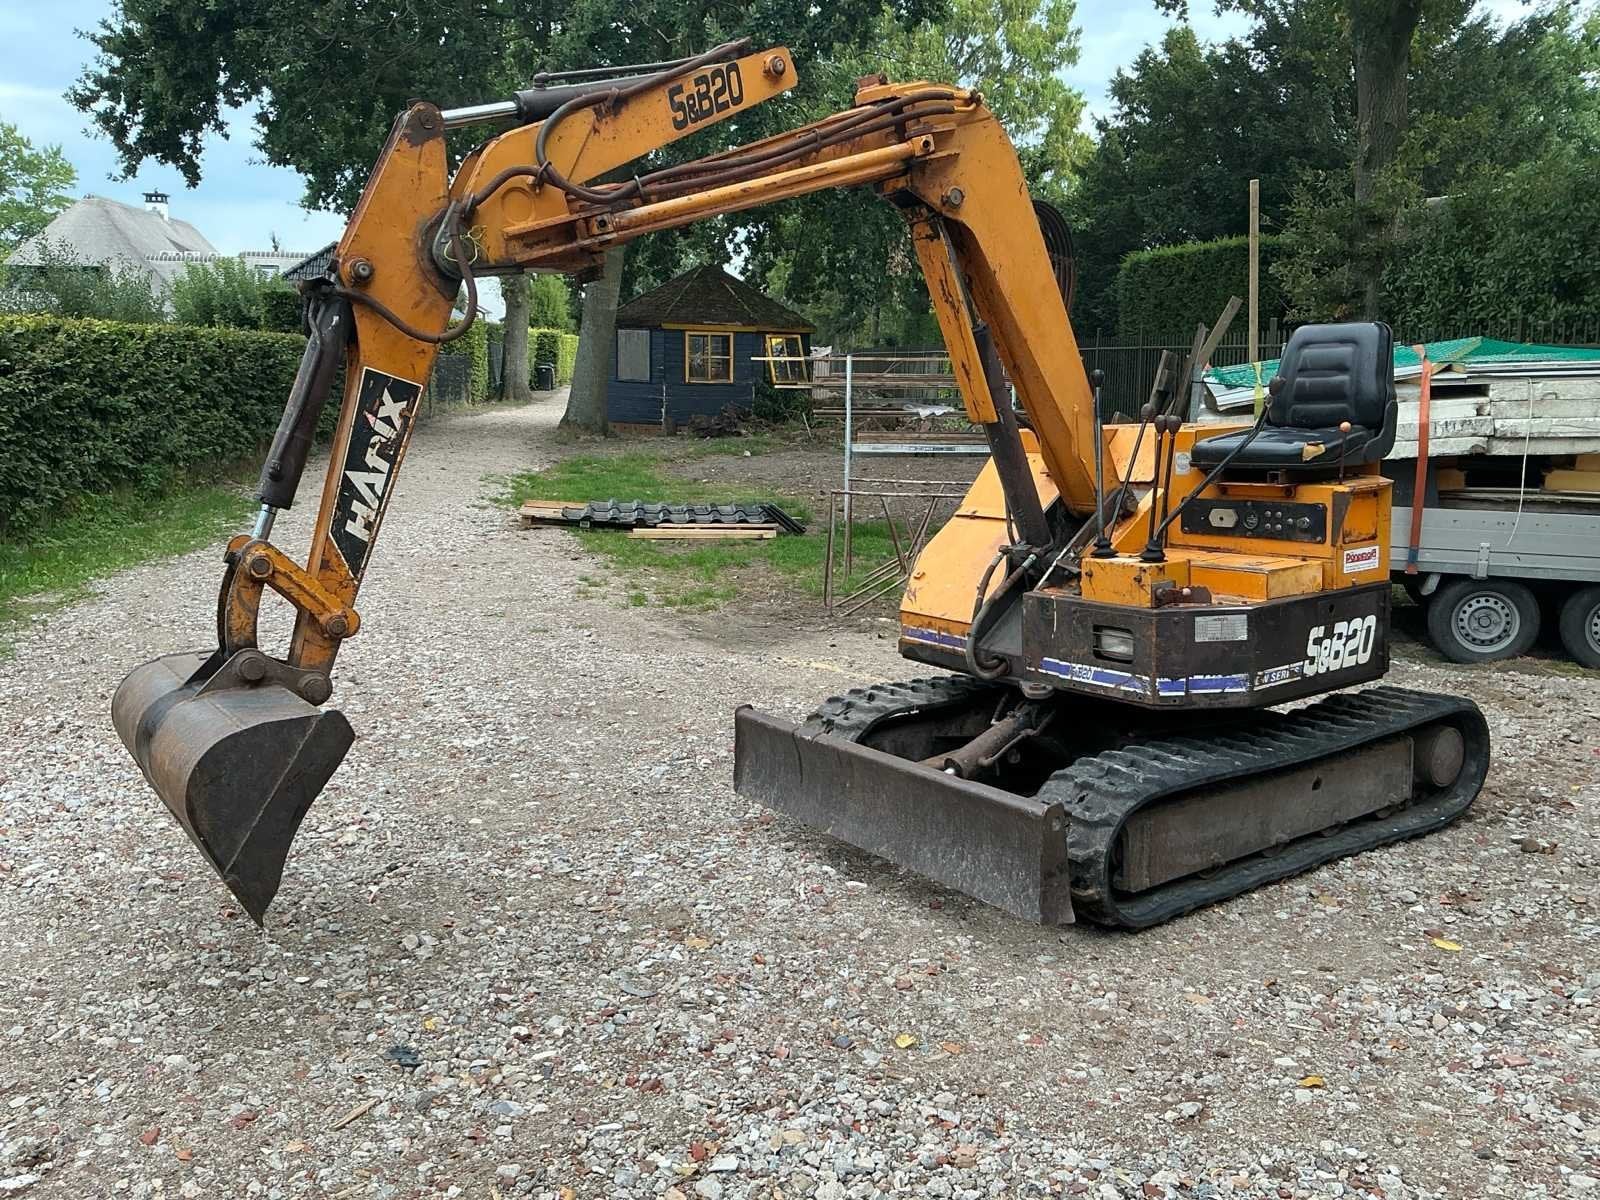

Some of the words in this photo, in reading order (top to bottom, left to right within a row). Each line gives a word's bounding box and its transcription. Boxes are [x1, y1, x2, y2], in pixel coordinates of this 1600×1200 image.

[668, 62, 743, 131] S&B20
[1270, 666, 1302, 682] SERIS
[1303, 614, 1376, 677] S&B20
